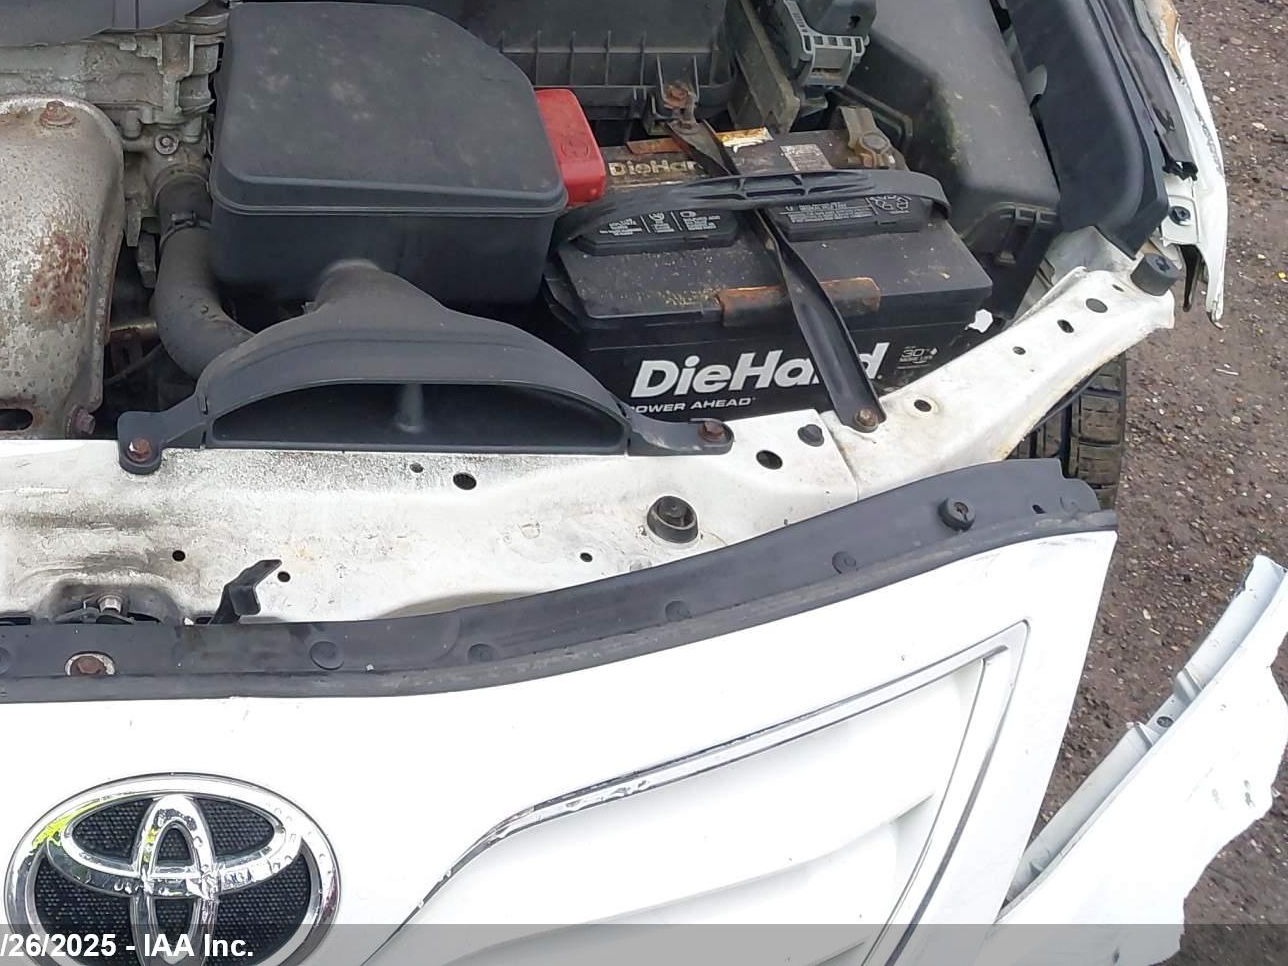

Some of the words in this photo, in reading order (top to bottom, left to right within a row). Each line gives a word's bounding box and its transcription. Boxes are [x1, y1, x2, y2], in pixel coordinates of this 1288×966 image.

[608, 160, 704, 177] DieHar
[630, 342, 890, 399] DieHad
[690, 397, 752, 410] AHEAD
